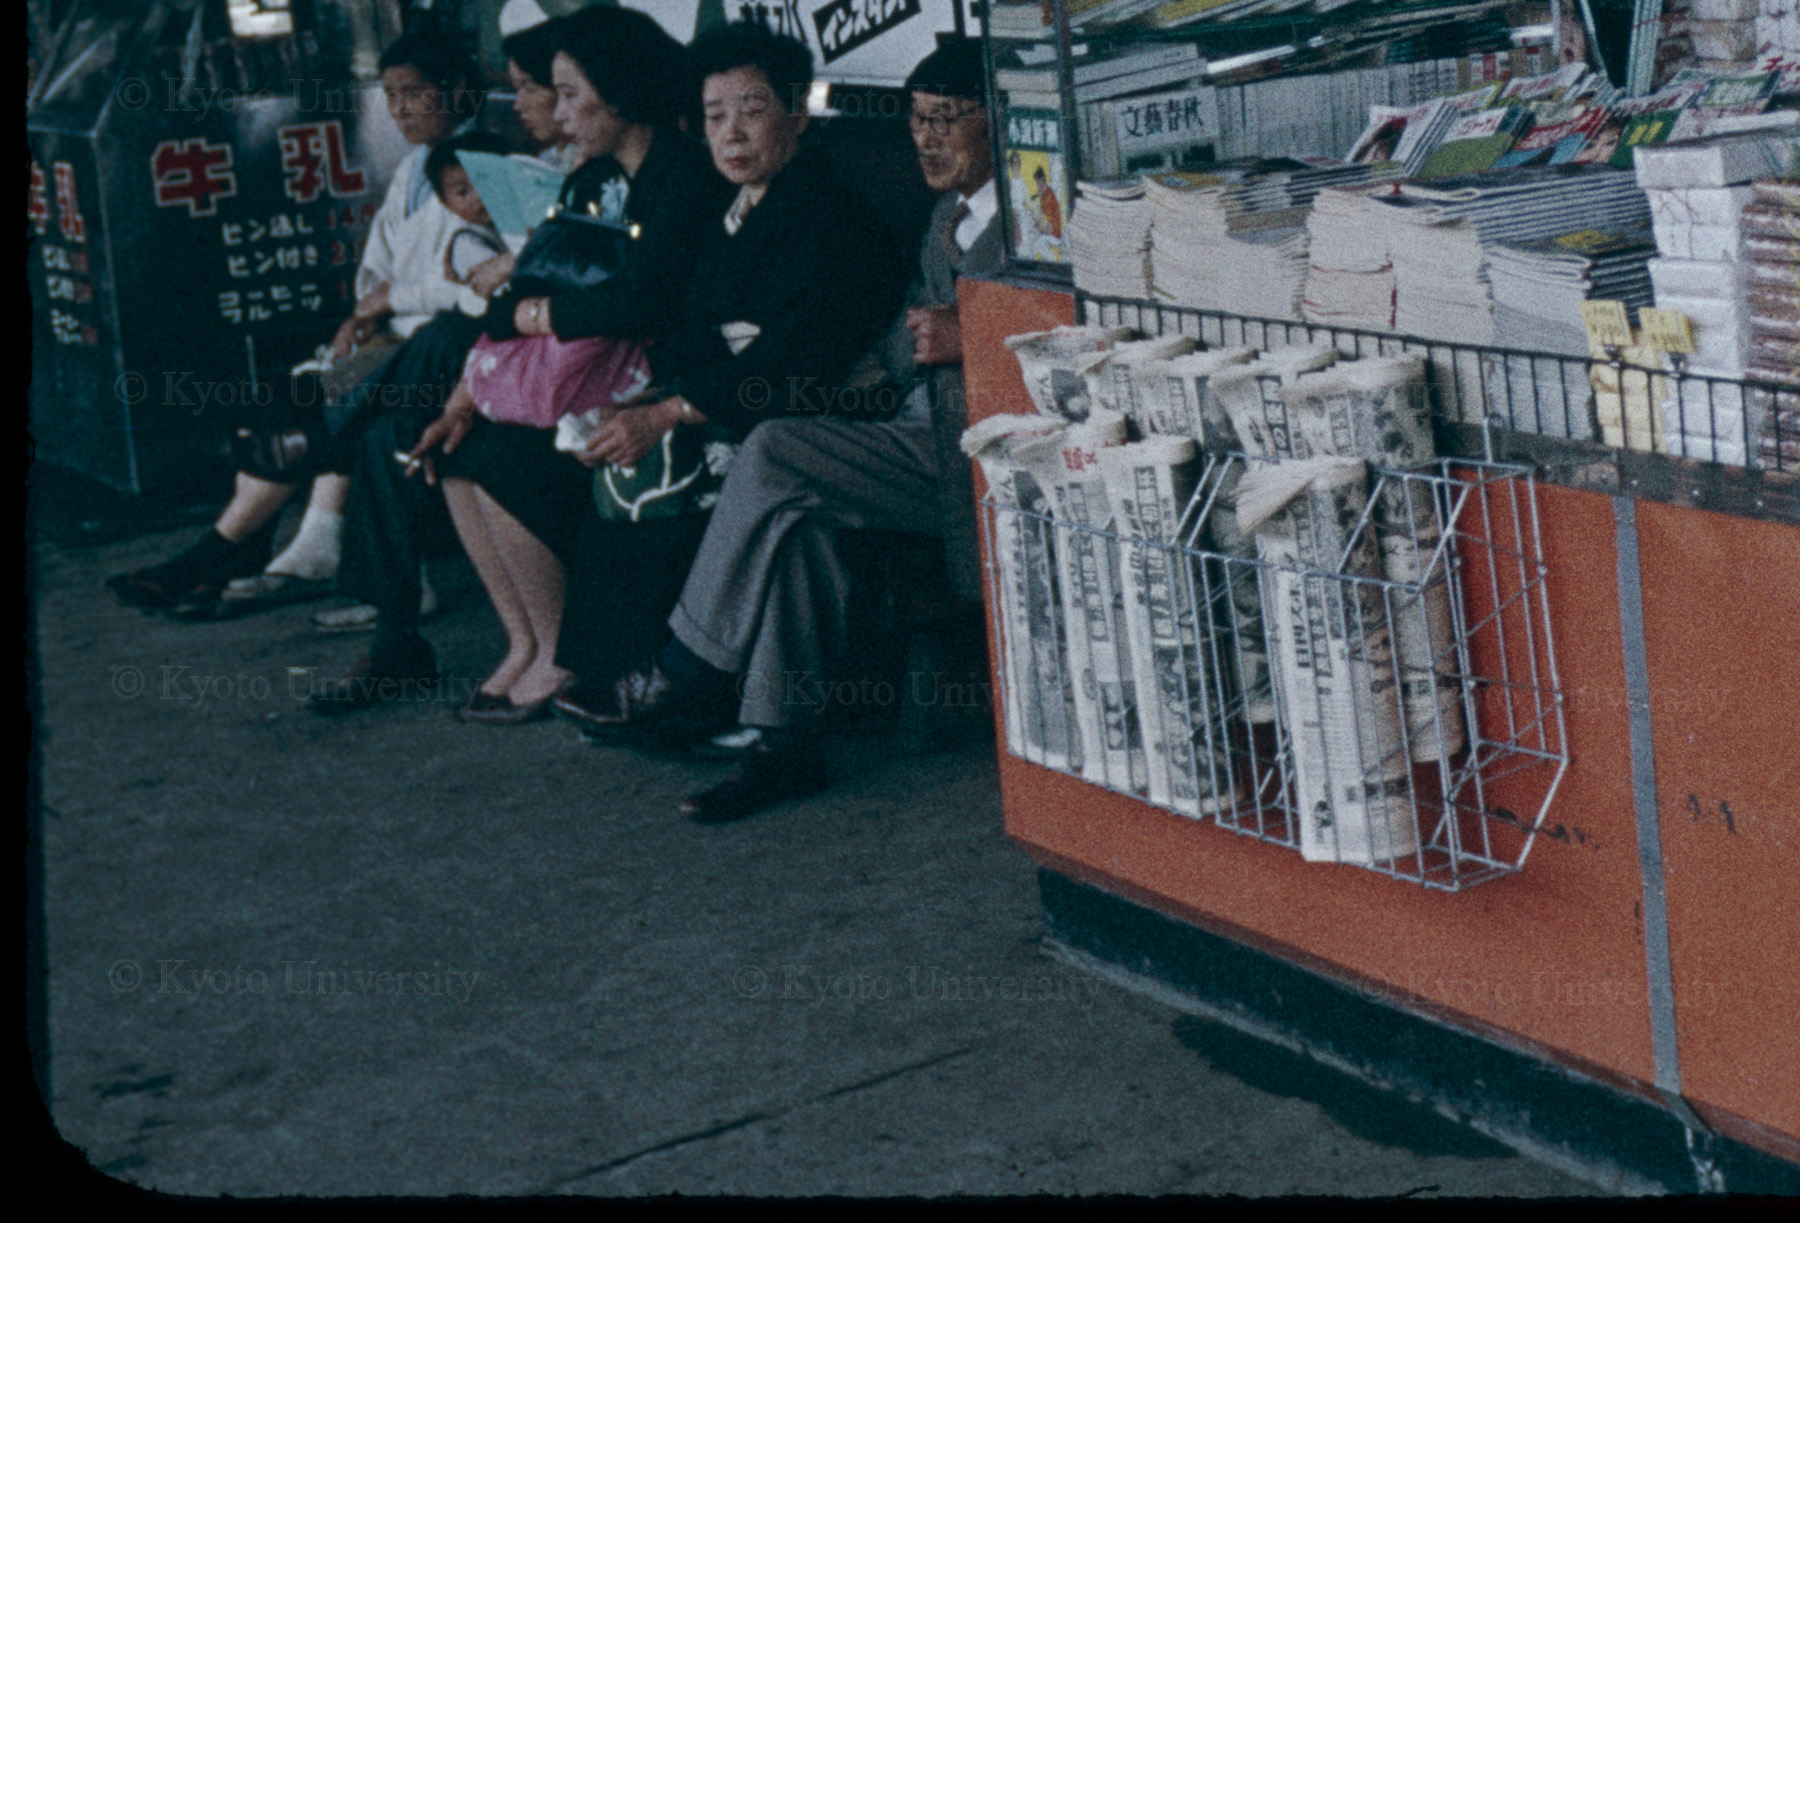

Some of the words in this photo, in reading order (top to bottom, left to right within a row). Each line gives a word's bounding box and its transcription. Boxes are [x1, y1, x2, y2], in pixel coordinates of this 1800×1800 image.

[1120, 86, 1204, 138] 文藝春秋
[149, 117, 369, 219] 牛乳
